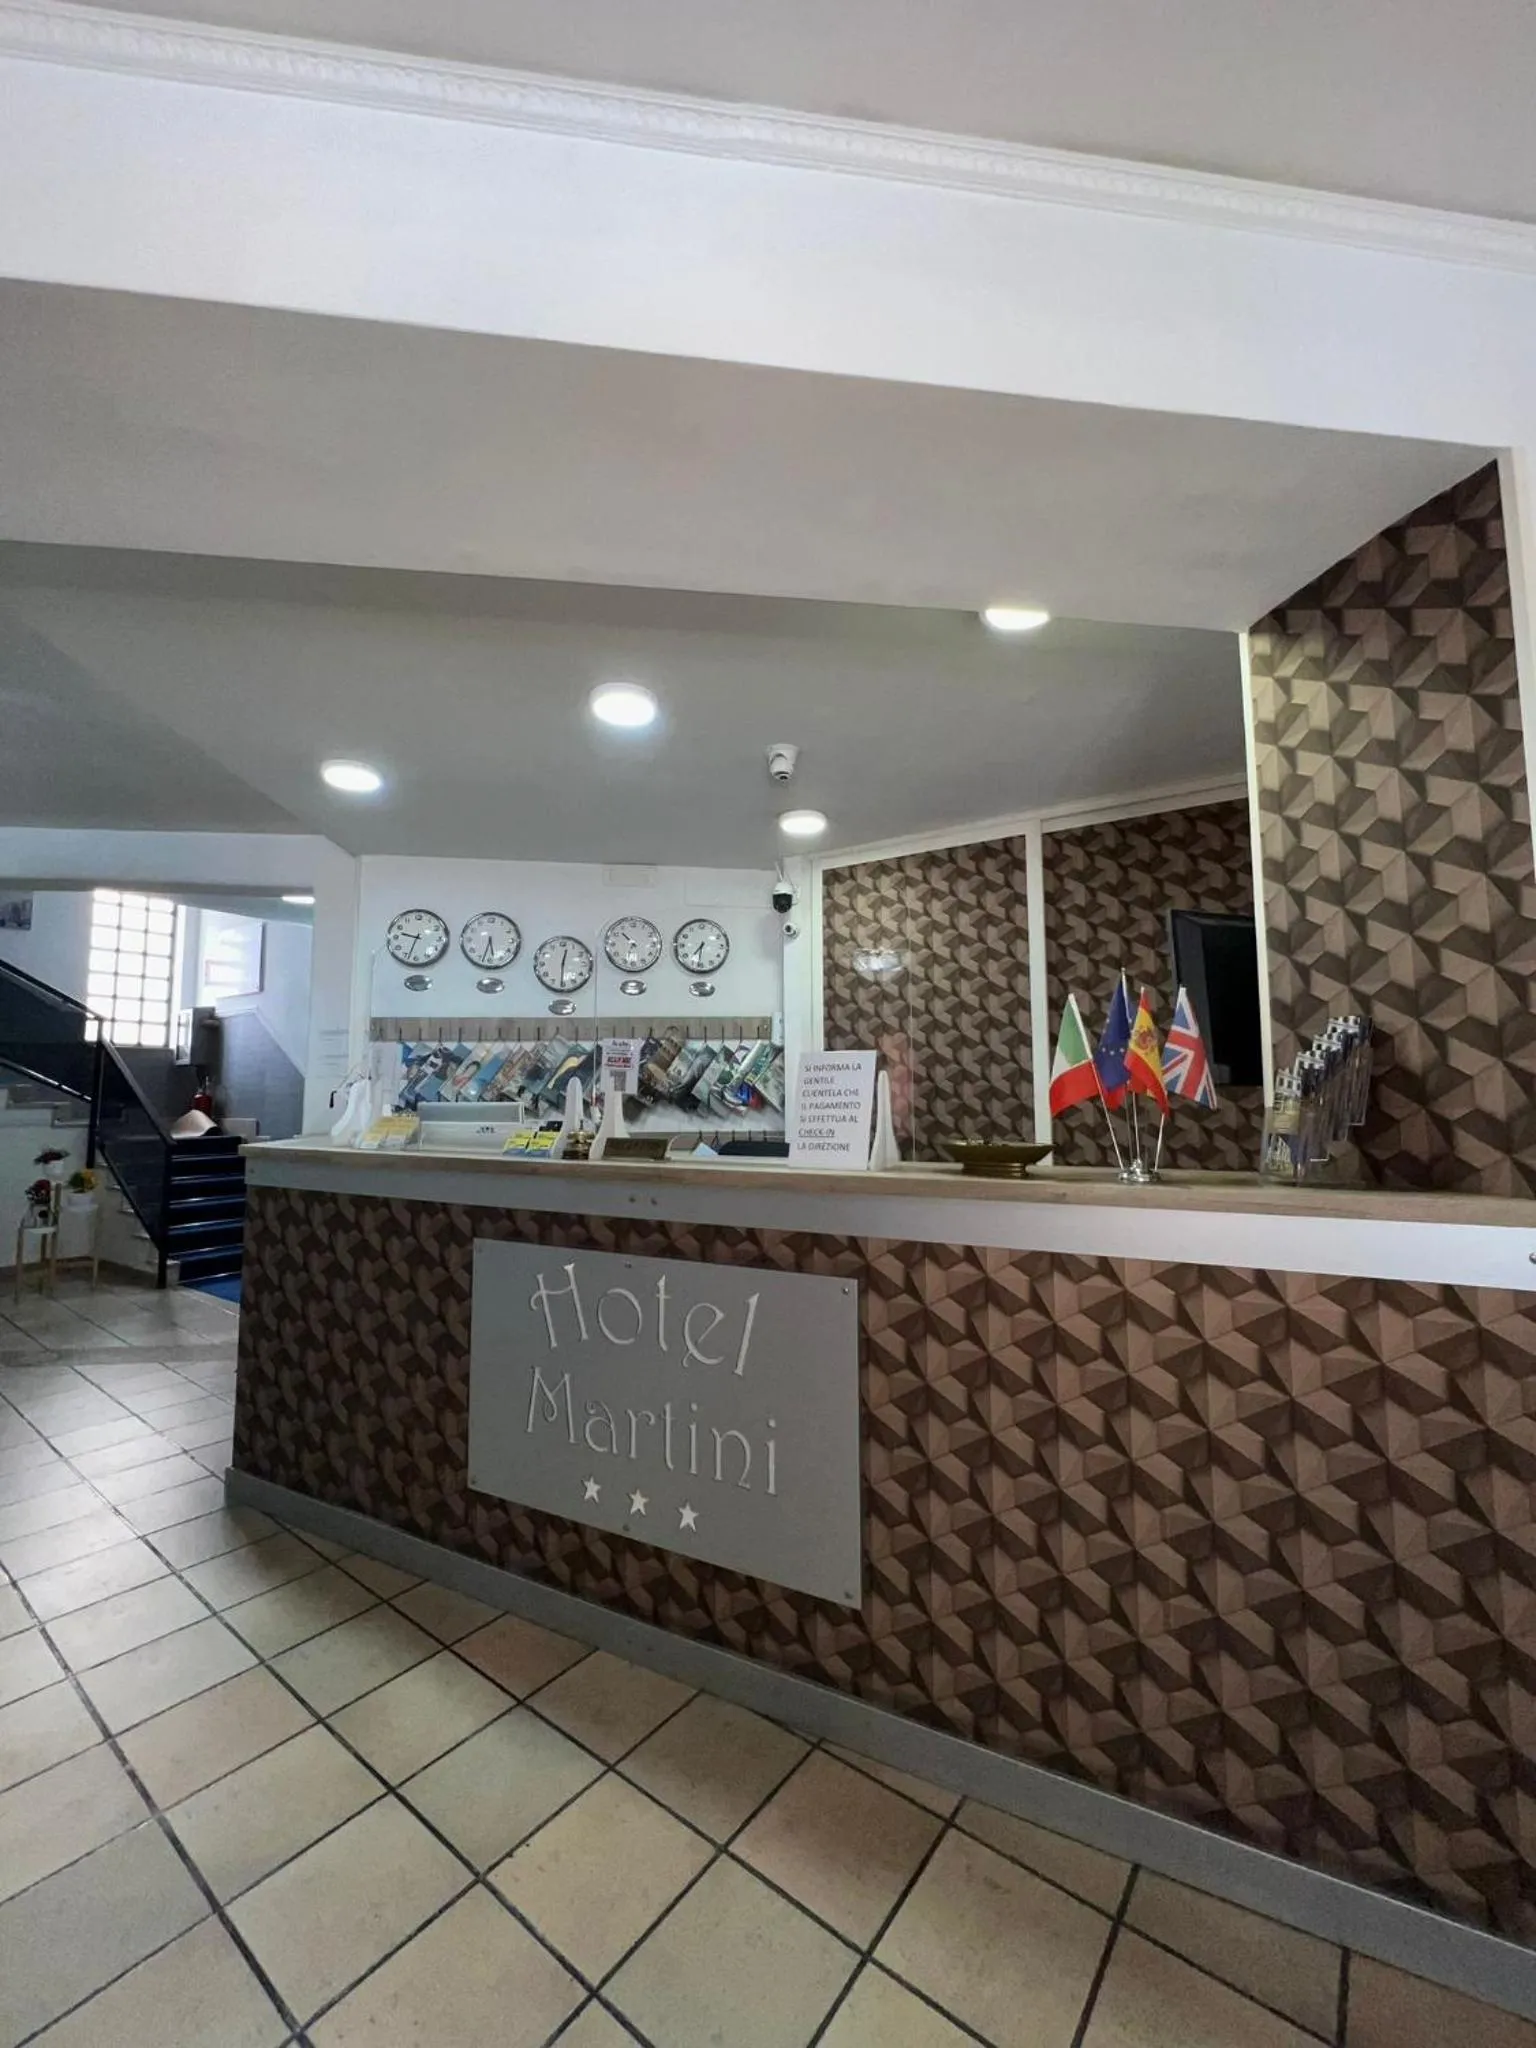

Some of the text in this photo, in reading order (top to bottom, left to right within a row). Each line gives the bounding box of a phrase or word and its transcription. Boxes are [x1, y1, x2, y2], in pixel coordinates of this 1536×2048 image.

[813, 1063, 850, 1072] INFORMA
[851, 1063, 861, 1071] LA
[803, 1076, 835, 1085] GENTILE
[802, 1088, 859, 1097] CLIENTELA CHE
[809, 1101, 861, 1110] PAGAMENTO
[808, 1114, 847, 1123] EFFETTUA
[848, 1114, 859, 1123] AL
[796, 1142, 850, 1152] LA DIREZIONE
[530, 1261, 760, 1377] Hotel
[525, 1366, 778, 1496] Martini
